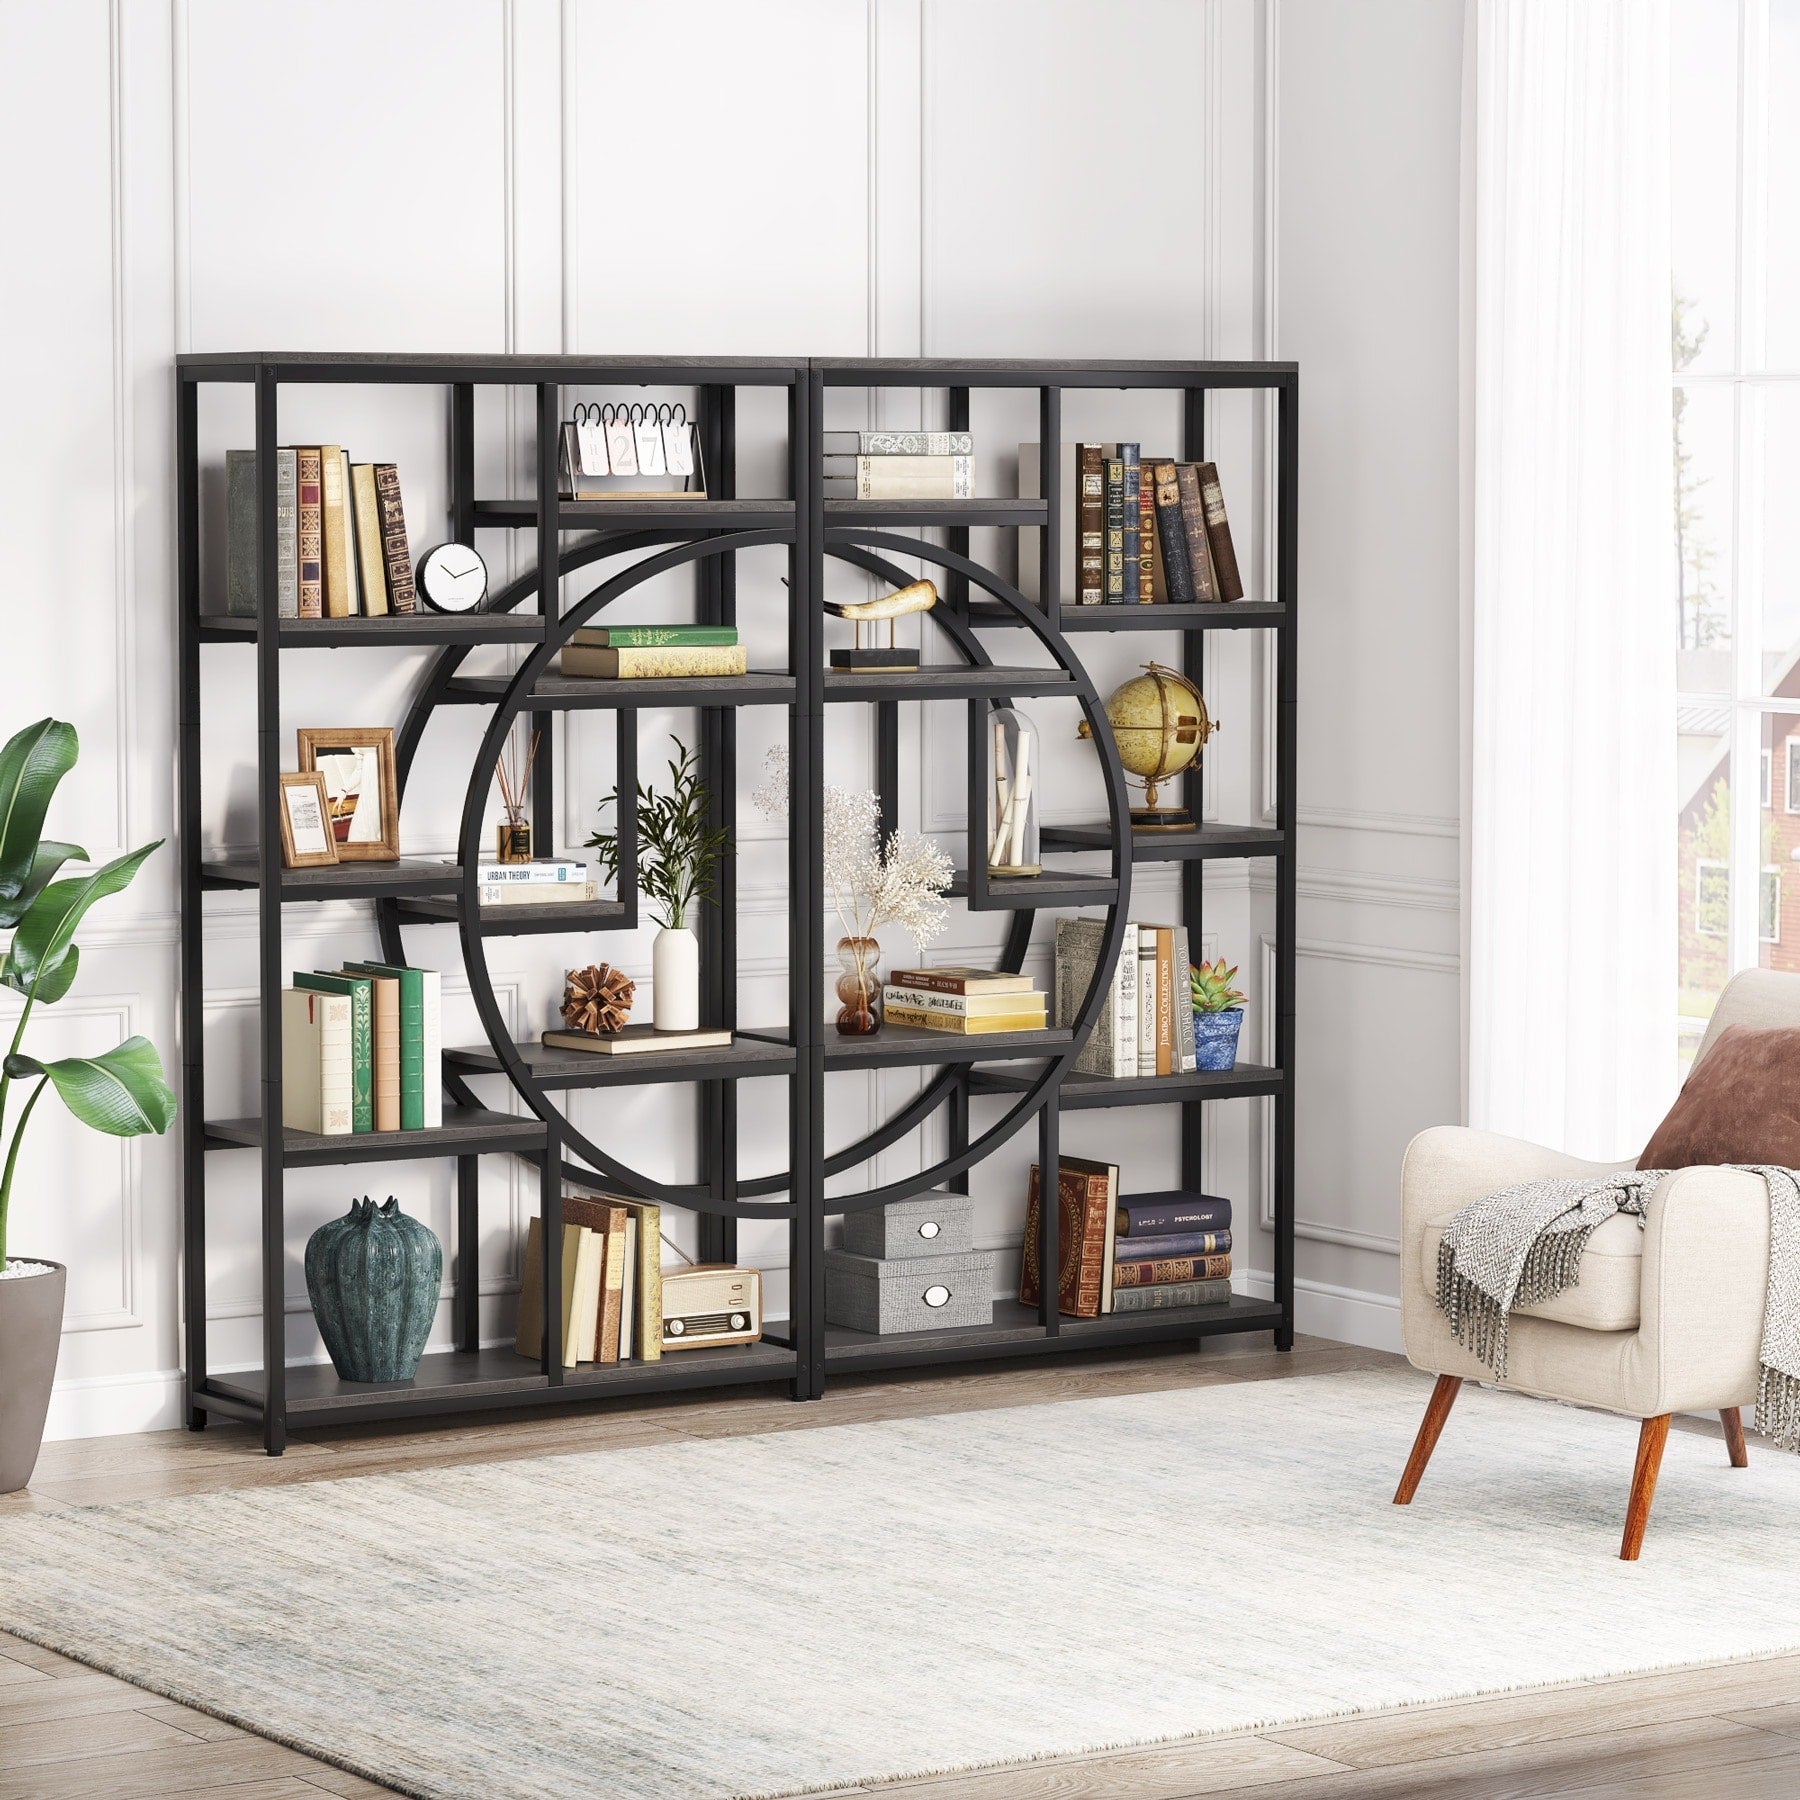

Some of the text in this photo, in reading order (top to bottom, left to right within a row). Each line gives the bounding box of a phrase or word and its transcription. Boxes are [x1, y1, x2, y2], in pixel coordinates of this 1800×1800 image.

[487, 871, 507, 881] URBAN
[509, 870, 531, 880] THEORY
[1178, 944, 1189, 981] YOUNG
[1160, 959, 1170, 1046] JUMBO COLLECTION
[1181, 1012, 1193, 1045] SHACK
[1174, 1213, 1213, 1223] PSYCHOLOGY
